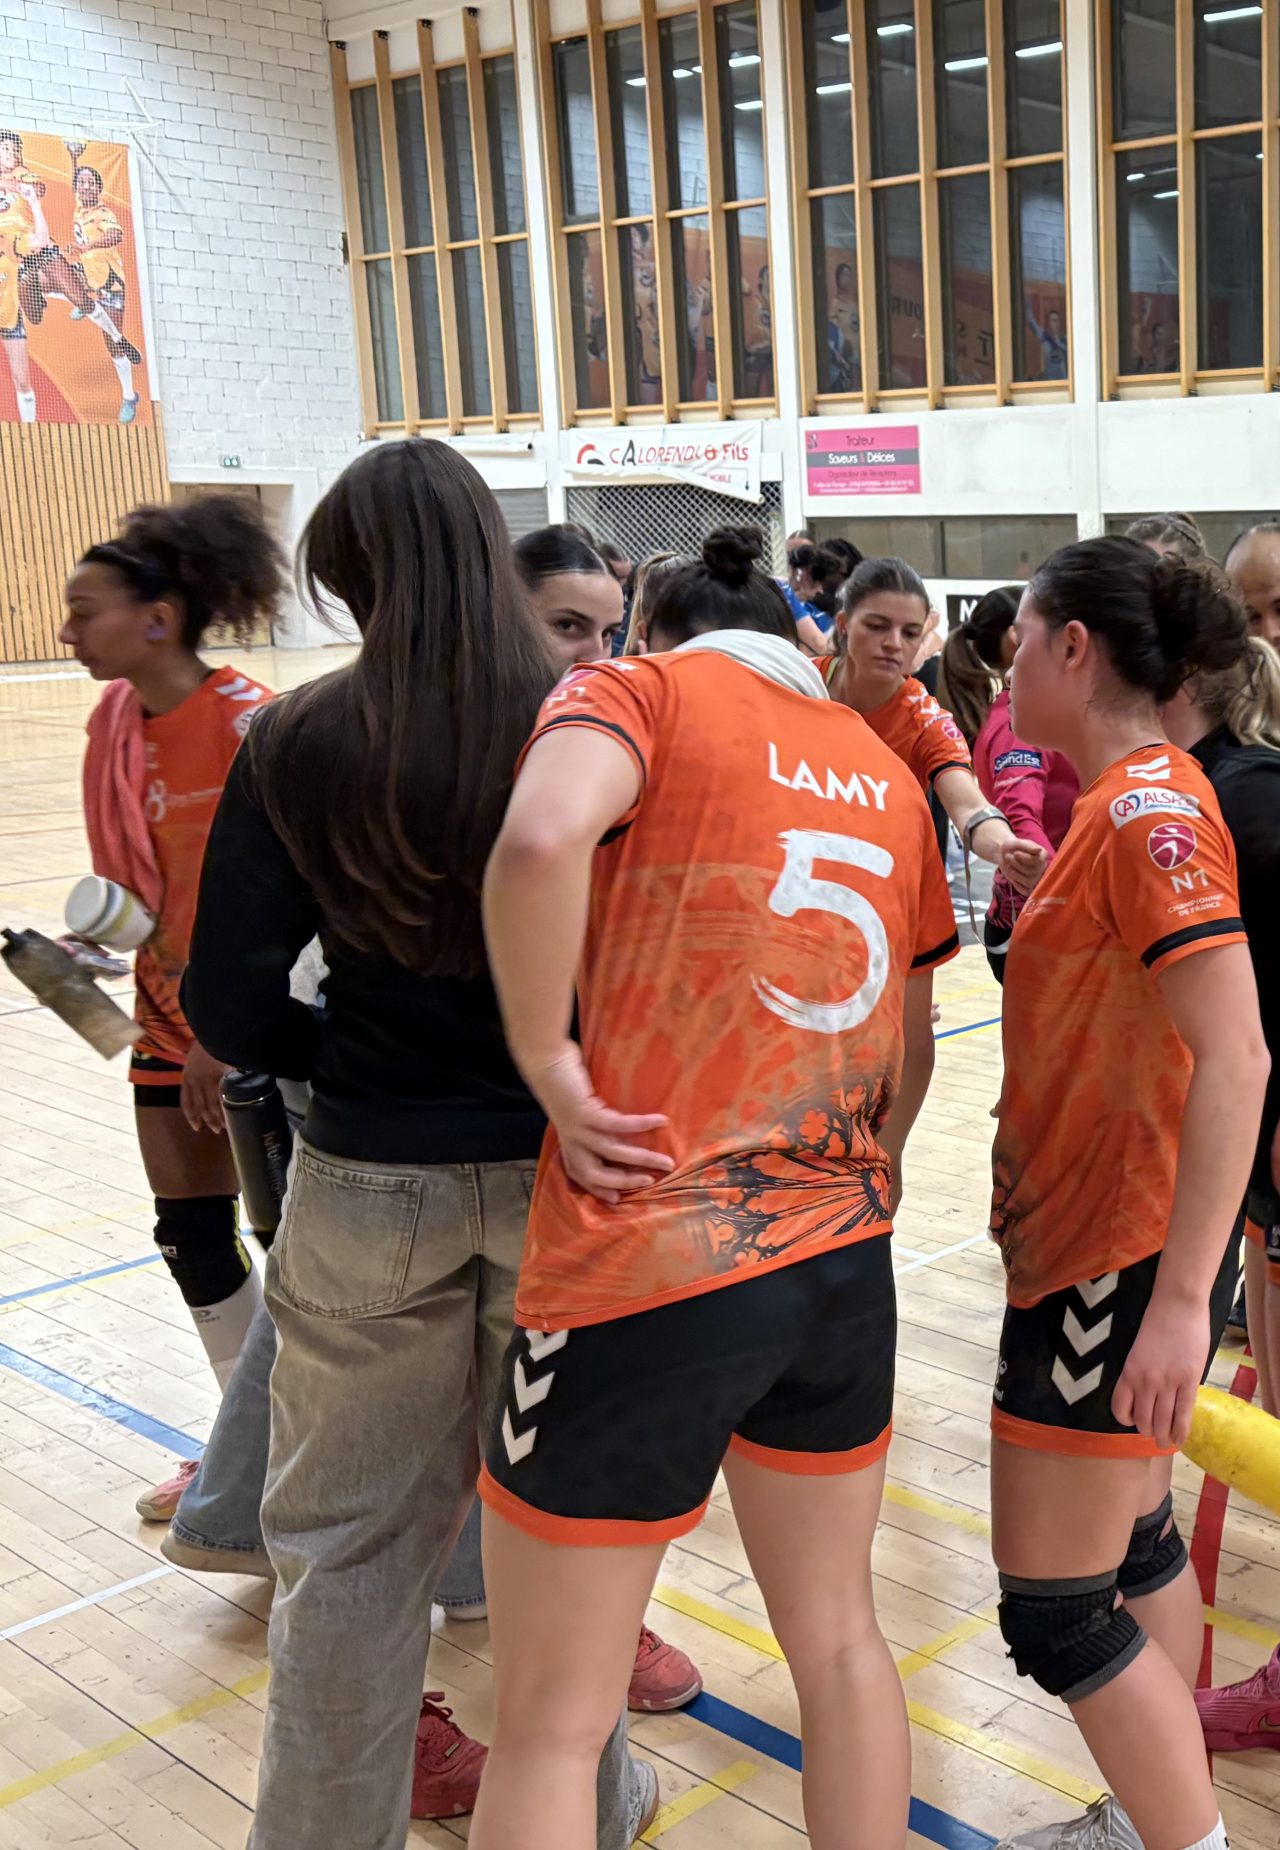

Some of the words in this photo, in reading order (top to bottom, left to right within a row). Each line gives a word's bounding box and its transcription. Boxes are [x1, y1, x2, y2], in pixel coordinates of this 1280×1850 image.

[768, 741, 889, 811] LAMY
[1170, 869, 1209, 894] N1
[750, 828, 895, 1034] 5
